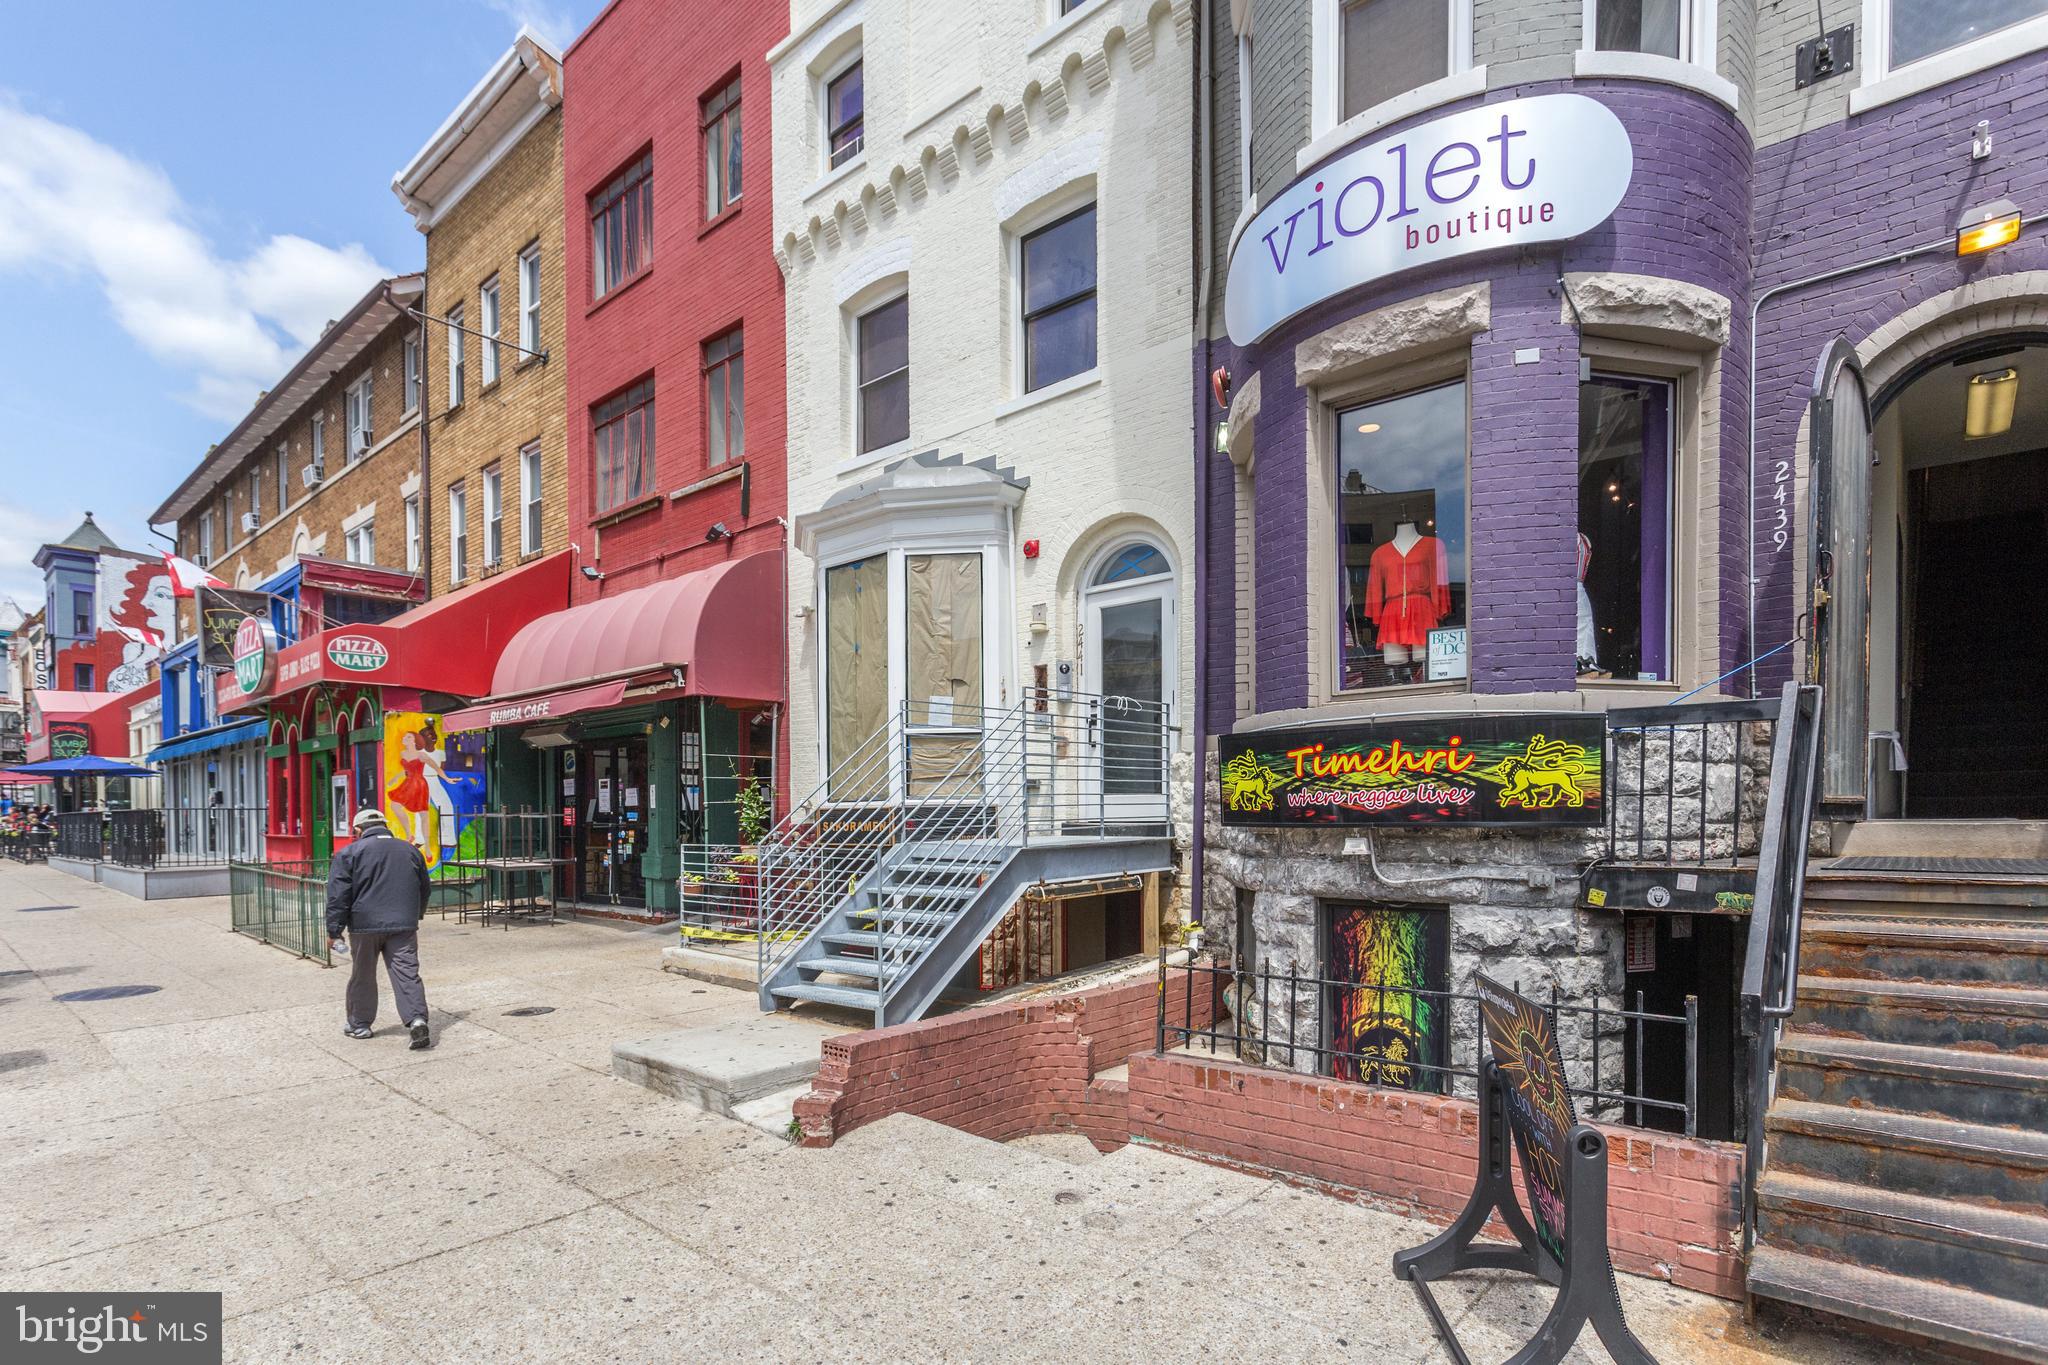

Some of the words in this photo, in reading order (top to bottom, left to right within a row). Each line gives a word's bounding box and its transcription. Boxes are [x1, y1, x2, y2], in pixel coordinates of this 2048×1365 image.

[1262, 114, 1536, 274] violet
[1406, 202, 1554, 249] boutique
[1773, 461, 1790, 553] 2439
[203, 618, 240, 630] JUMB
[1432, 631, 1466, 644] BEST
[237, 624, 262, 657] PIZZA
[335, 638, 384, 655] PIZZA
[237, 653, 263, 685] MART
[335, 653, 382, 669] MART
[489, 707, 522, 723] RUMBA
[523, 702, 550, 718] CAFE
[1287, 736, 1475, 777] Timehri
[1287, 787, 1346, 807] where
[1347, 787, 1415, 809] reggae
[1416, 783, 1475, 805] lives
[1523, 1131, 1562, 1202] HOT
